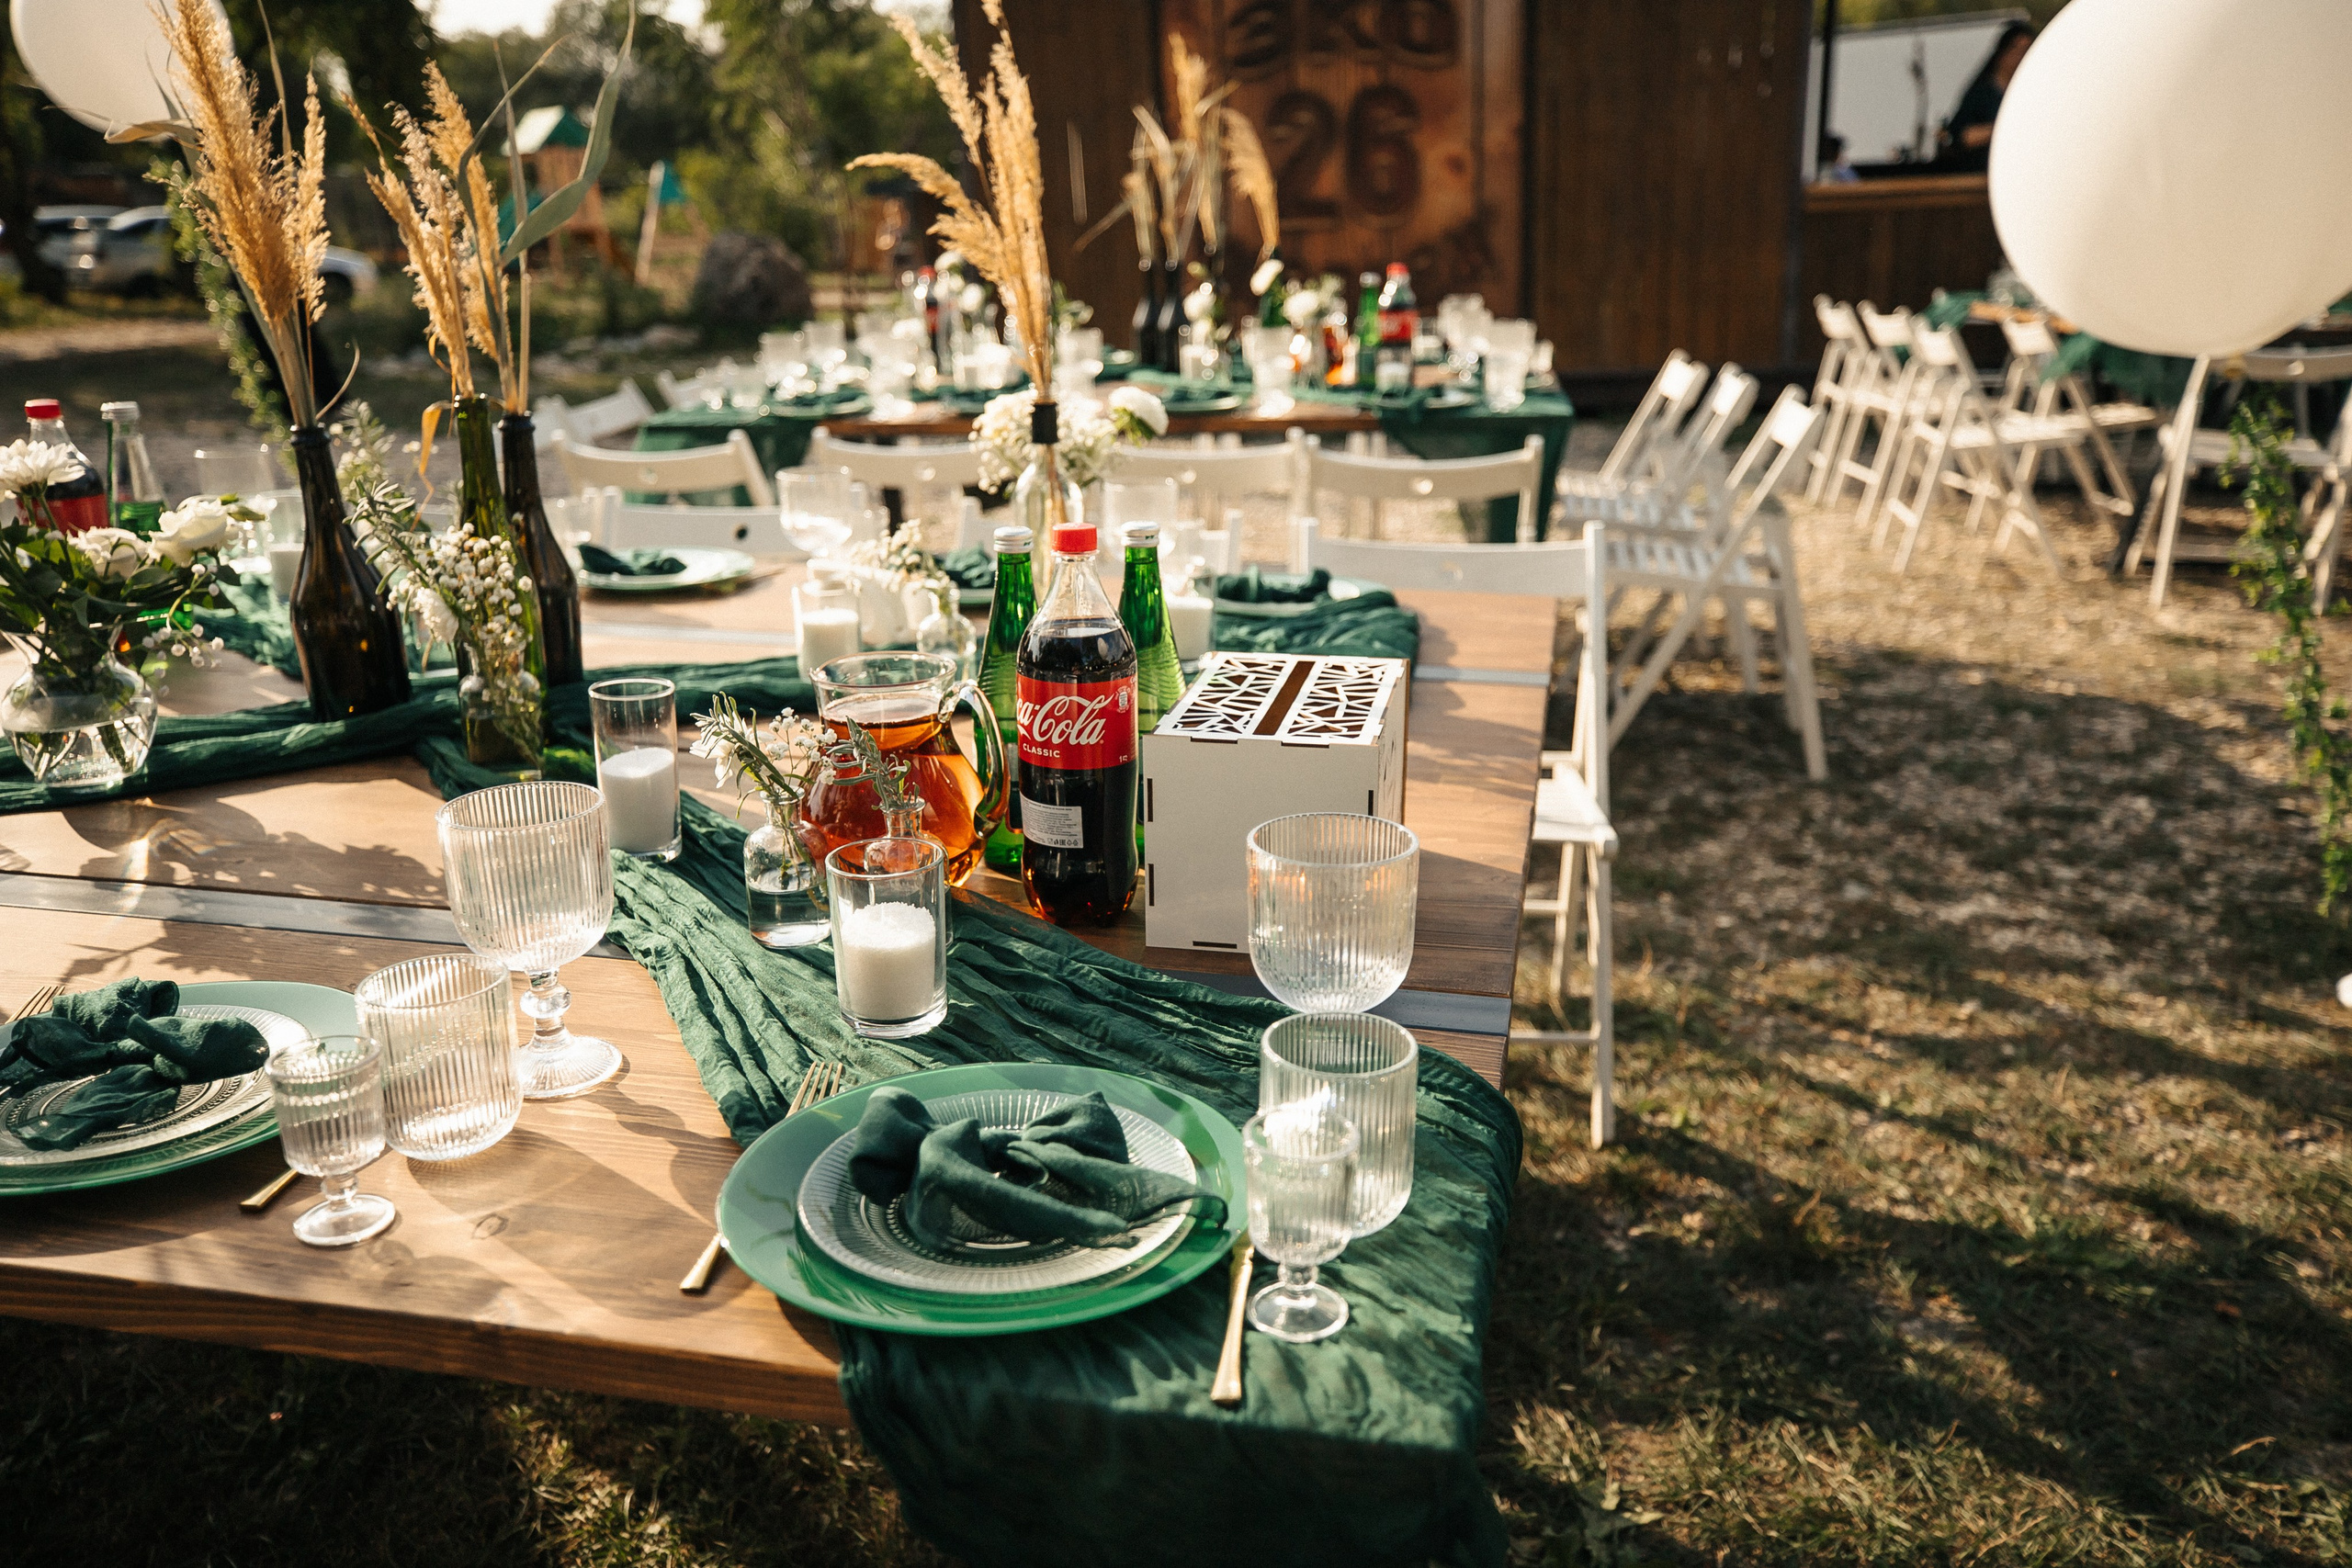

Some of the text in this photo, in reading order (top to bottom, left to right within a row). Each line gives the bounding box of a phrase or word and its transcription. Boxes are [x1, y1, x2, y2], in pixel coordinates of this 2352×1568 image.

[1264, 85, 1424, 218] 26
[1016, 694, 1114, 745] ca-Cola
[1023, 742, 1060, 758] CLASSIC
